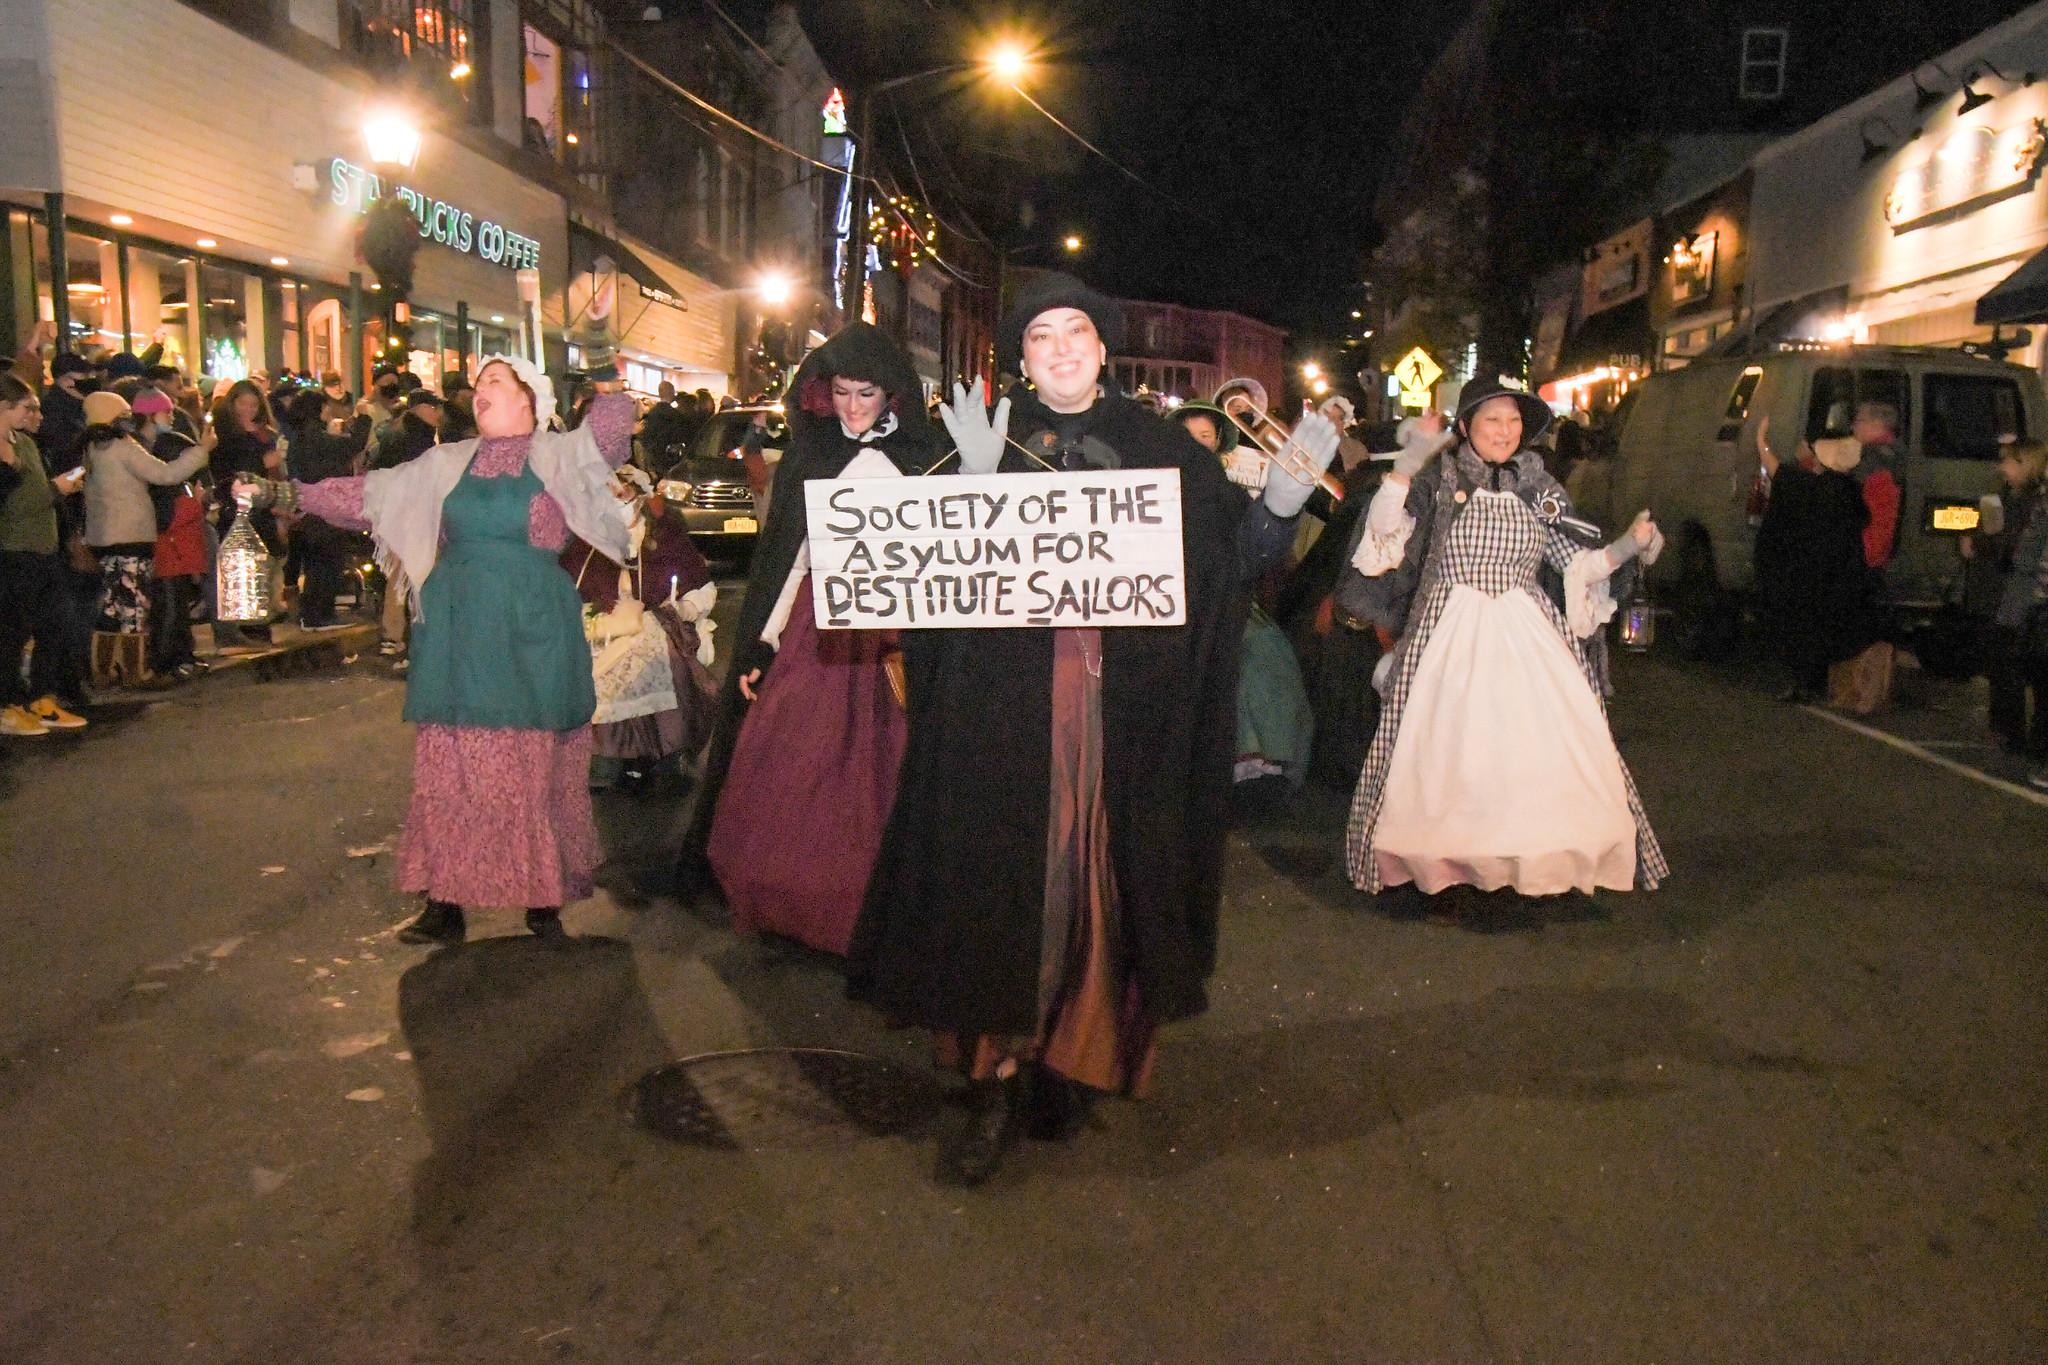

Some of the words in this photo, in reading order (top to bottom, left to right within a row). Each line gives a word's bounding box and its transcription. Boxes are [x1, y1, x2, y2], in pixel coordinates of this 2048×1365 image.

[331, 158, 473, 252] STAUCKS
[478, 221, 541, 270] COFFEE
[1018, 490, 1067, 525] OF
[1081, 484, 1162, 525] THE
[1033, 531, 1114, 564] FOR
[825, 570, 1016, 622] DESTITUTE
[1027, 570, 1175, 621] SAILORS
